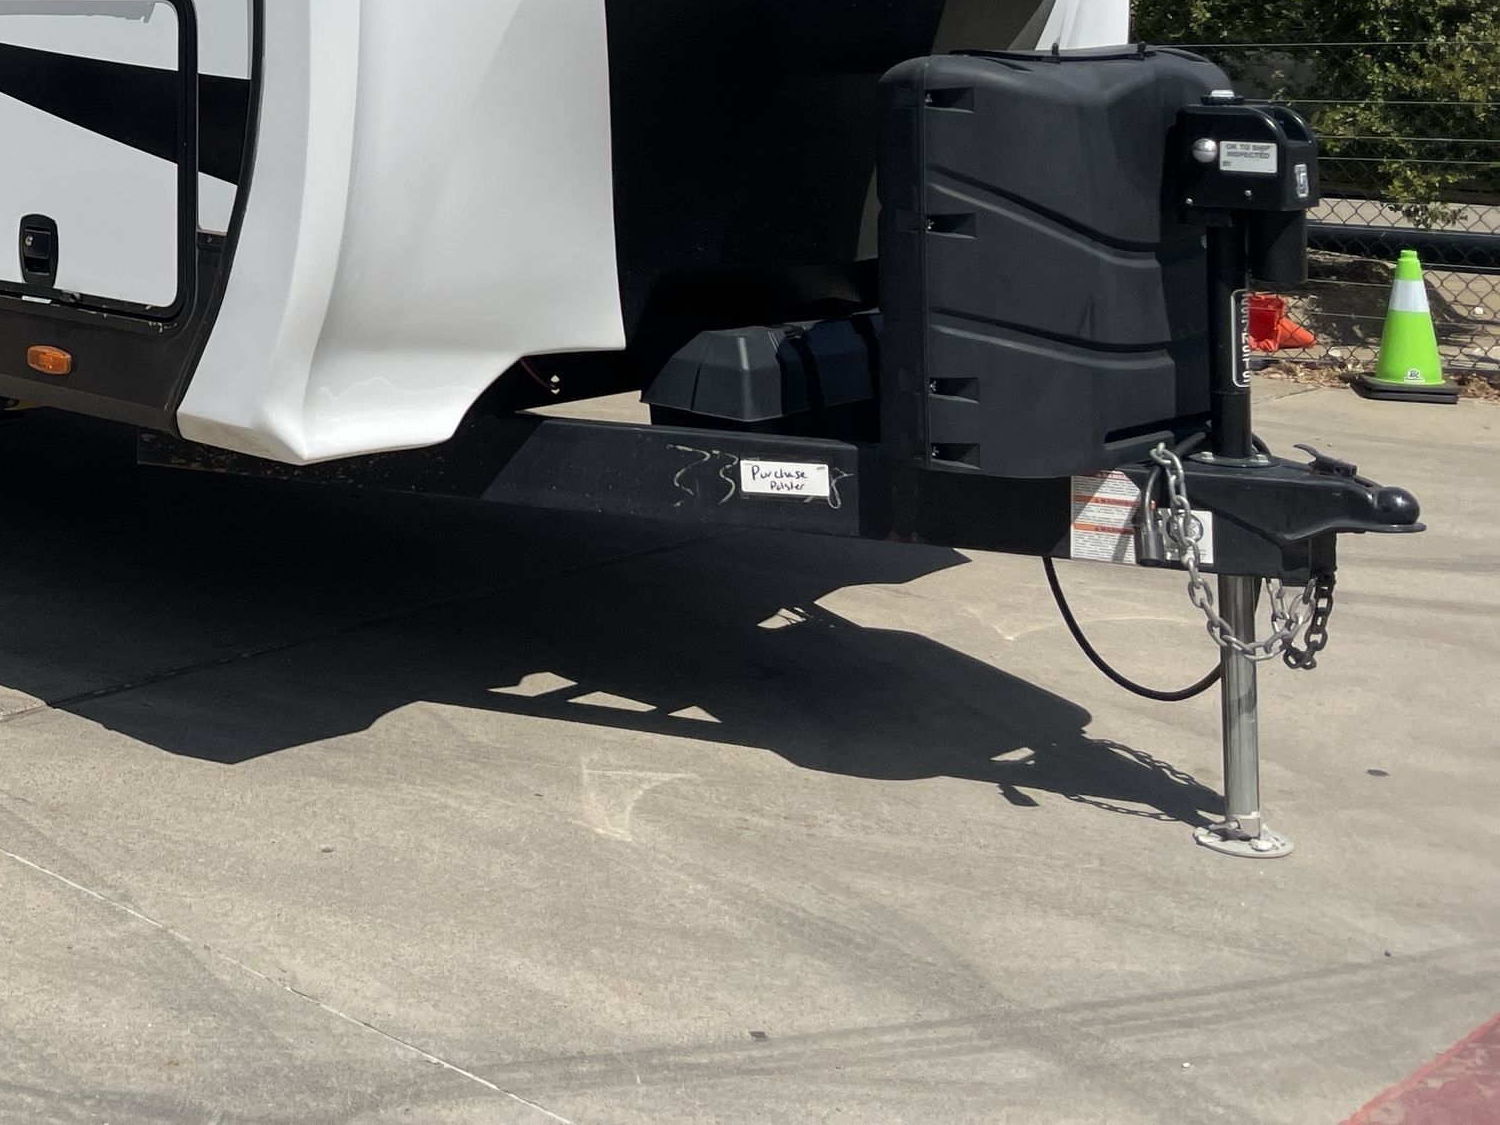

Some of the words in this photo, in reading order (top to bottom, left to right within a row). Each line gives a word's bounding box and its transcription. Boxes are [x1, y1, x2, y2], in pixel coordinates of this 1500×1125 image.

[1226, 143, 1238, 151] OK
[1226, 151, 1269, 159] INSPECTED
[751, 464, 808, 481] Purchase
